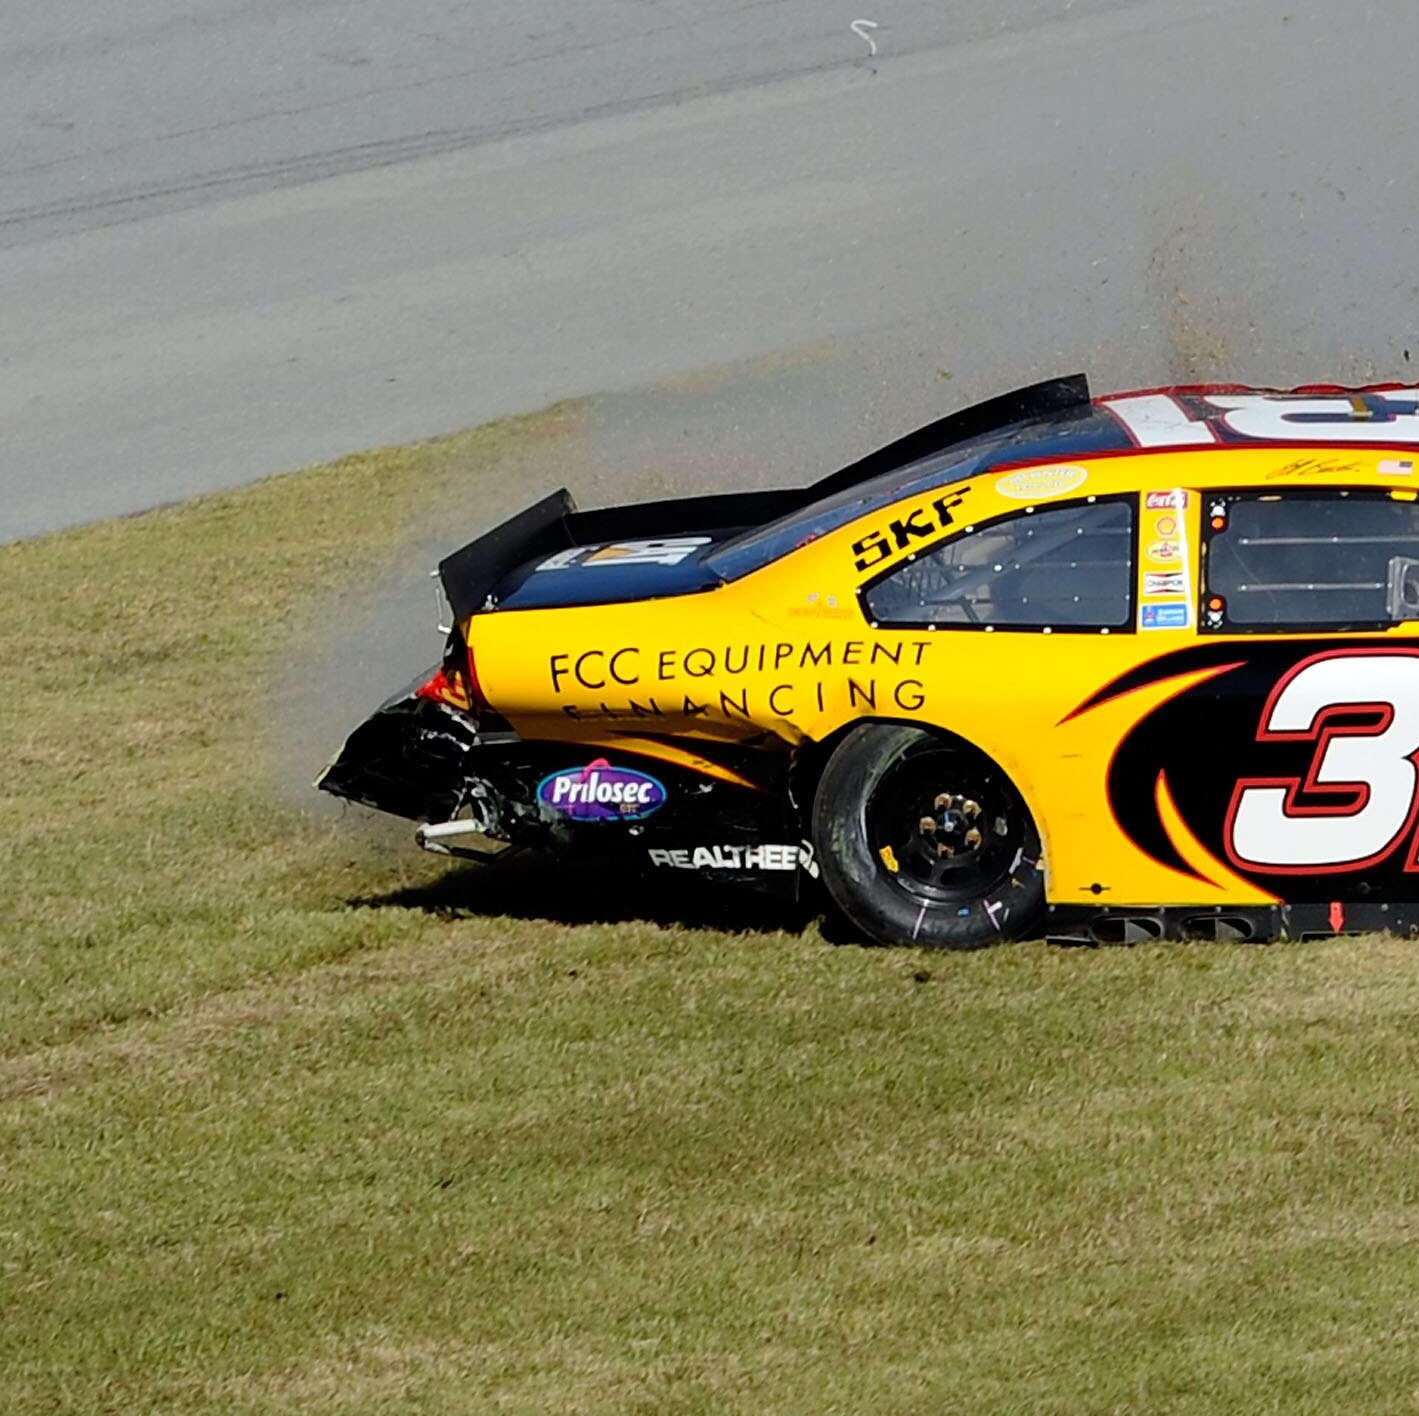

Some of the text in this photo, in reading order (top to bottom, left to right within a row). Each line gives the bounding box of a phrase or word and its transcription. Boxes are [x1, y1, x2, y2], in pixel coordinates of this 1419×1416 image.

[852, 485, 971, 574] SKF
[550, 640, 933, 693] FCC EQUIPMENT
[552, 771, 654, 804] Prilosec
